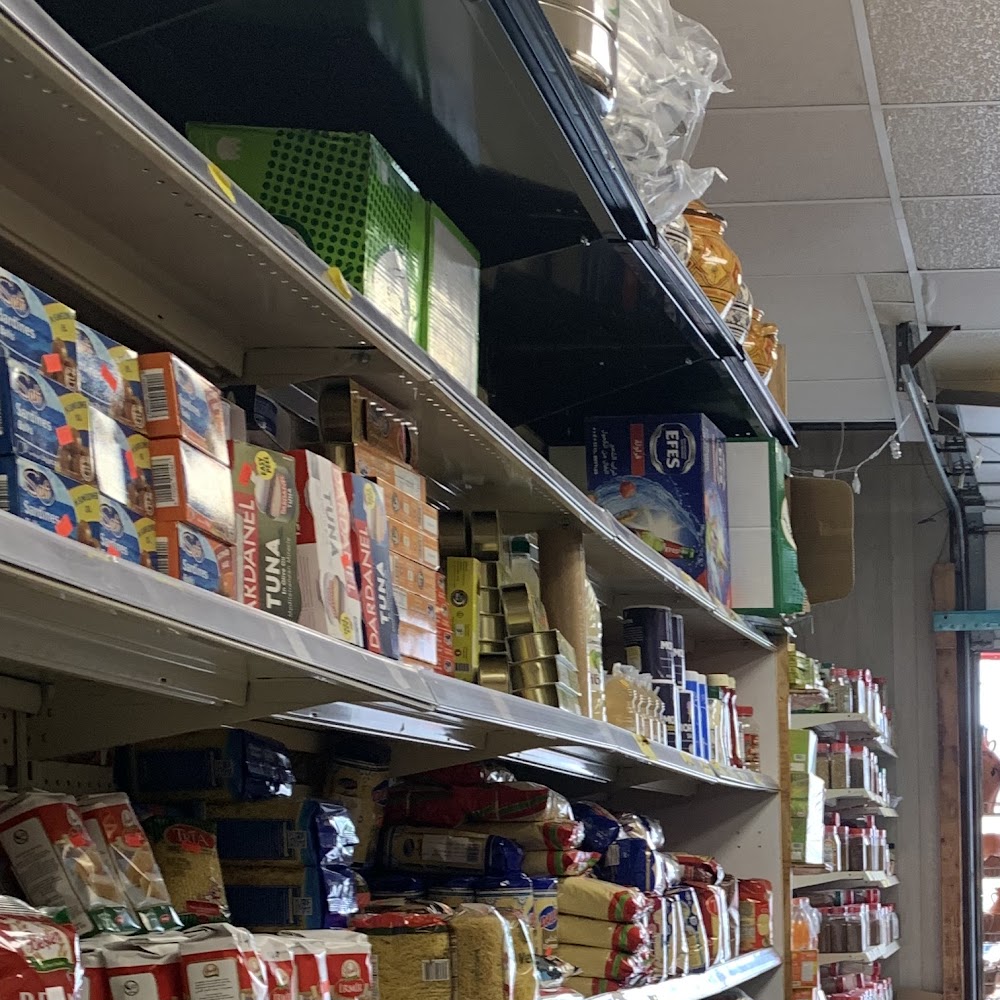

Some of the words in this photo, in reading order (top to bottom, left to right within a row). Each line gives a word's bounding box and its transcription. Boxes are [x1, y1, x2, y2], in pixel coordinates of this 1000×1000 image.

[665, 430, 681, 469] EFES
[238, 499, 259, 609] ARDANEL
[323, 492, 340, 557] TUNA
[264, 538, 283, 609] TUNA
[359, 526, 381, 649] DARDANEL
[375, 562, 391, 625] TUNA
